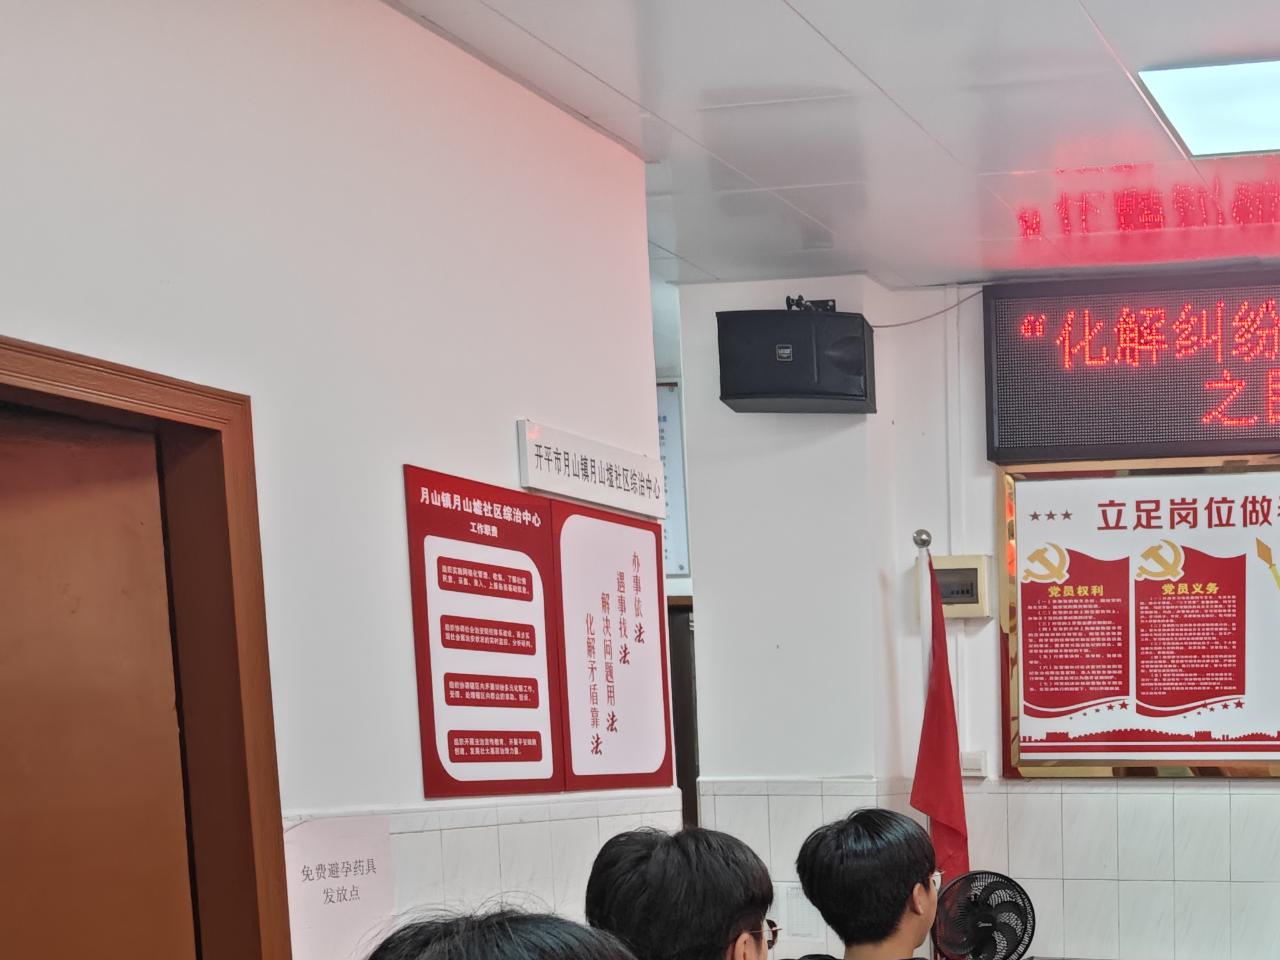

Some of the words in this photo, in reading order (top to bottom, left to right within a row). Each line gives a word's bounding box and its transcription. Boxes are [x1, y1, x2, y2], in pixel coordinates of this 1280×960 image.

[420, 486, 541, 527] 月山镇月山墟社区综治中心
[469, 521, 498, 538] 工作职责
[632, 552, 645, 645] 办事依法
[1047, 585, 1104, 598] 党员权利
[1161, 582, 1219, 595] 党员义务
[600, 592, 618, 733] 解决问题用法
[585, 613, 603, 756] 化解矛盾靠法
[301, 858, 377, 882] 免费避孕药具
[322, 885, 360, 905] 发放点
